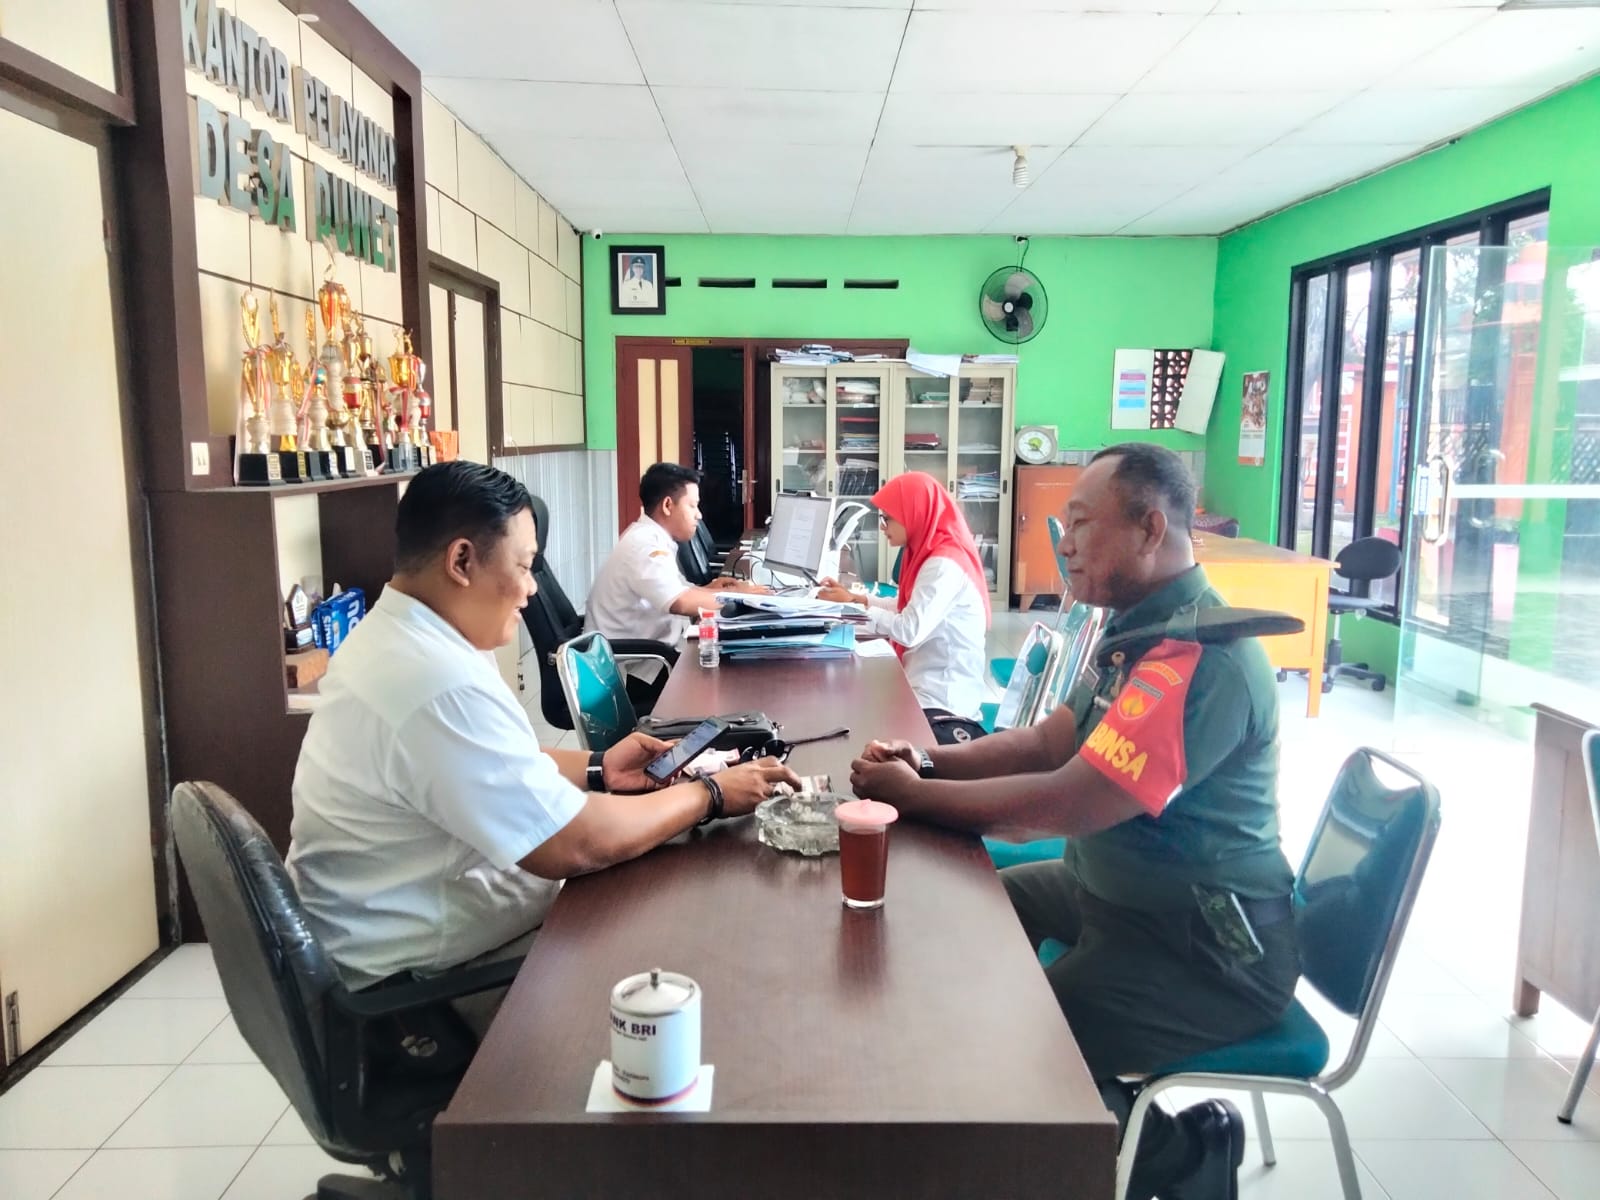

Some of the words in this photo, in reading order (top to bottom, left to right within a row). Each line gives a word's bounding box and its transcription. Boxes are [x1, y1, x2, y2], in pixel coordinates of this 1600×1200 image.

[179, 0, 292, 125] KANTOR
[192, 95, 296, 233] DESA
[309, 162, 398, 272] DUWET
[610, 1012, 627, 1032] NK
[632, 1023, 656, 1036] BRI
